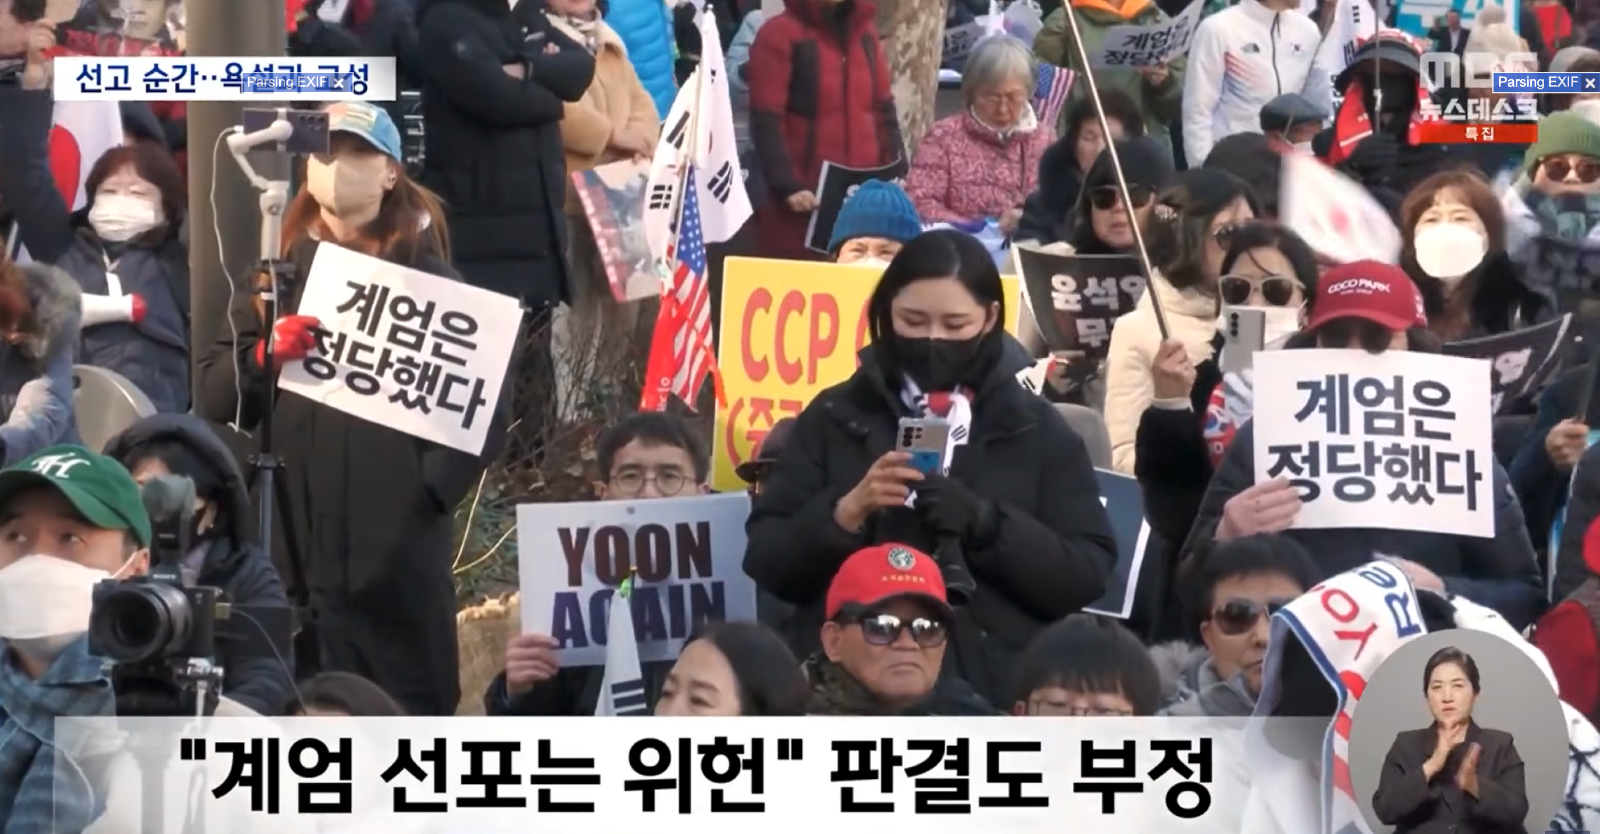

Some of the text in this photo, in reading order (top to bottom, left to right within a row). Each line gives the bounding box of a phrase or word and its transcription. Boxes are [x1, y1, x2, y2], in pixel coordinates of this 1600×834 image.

[1327, 279, 1358, 294] COCO
[1359, 278, 1391, 293] PARK
[336, 280, 479, 367] 계엄은
[740, 286, 841, 385] CCP
[302, 328, 487, 430] 정당했다
[1293, 373, 1456, 442] 계엄은
[1266, 441, 1483, 512] 정당했다
[557, 520, 713, 587] YOON
